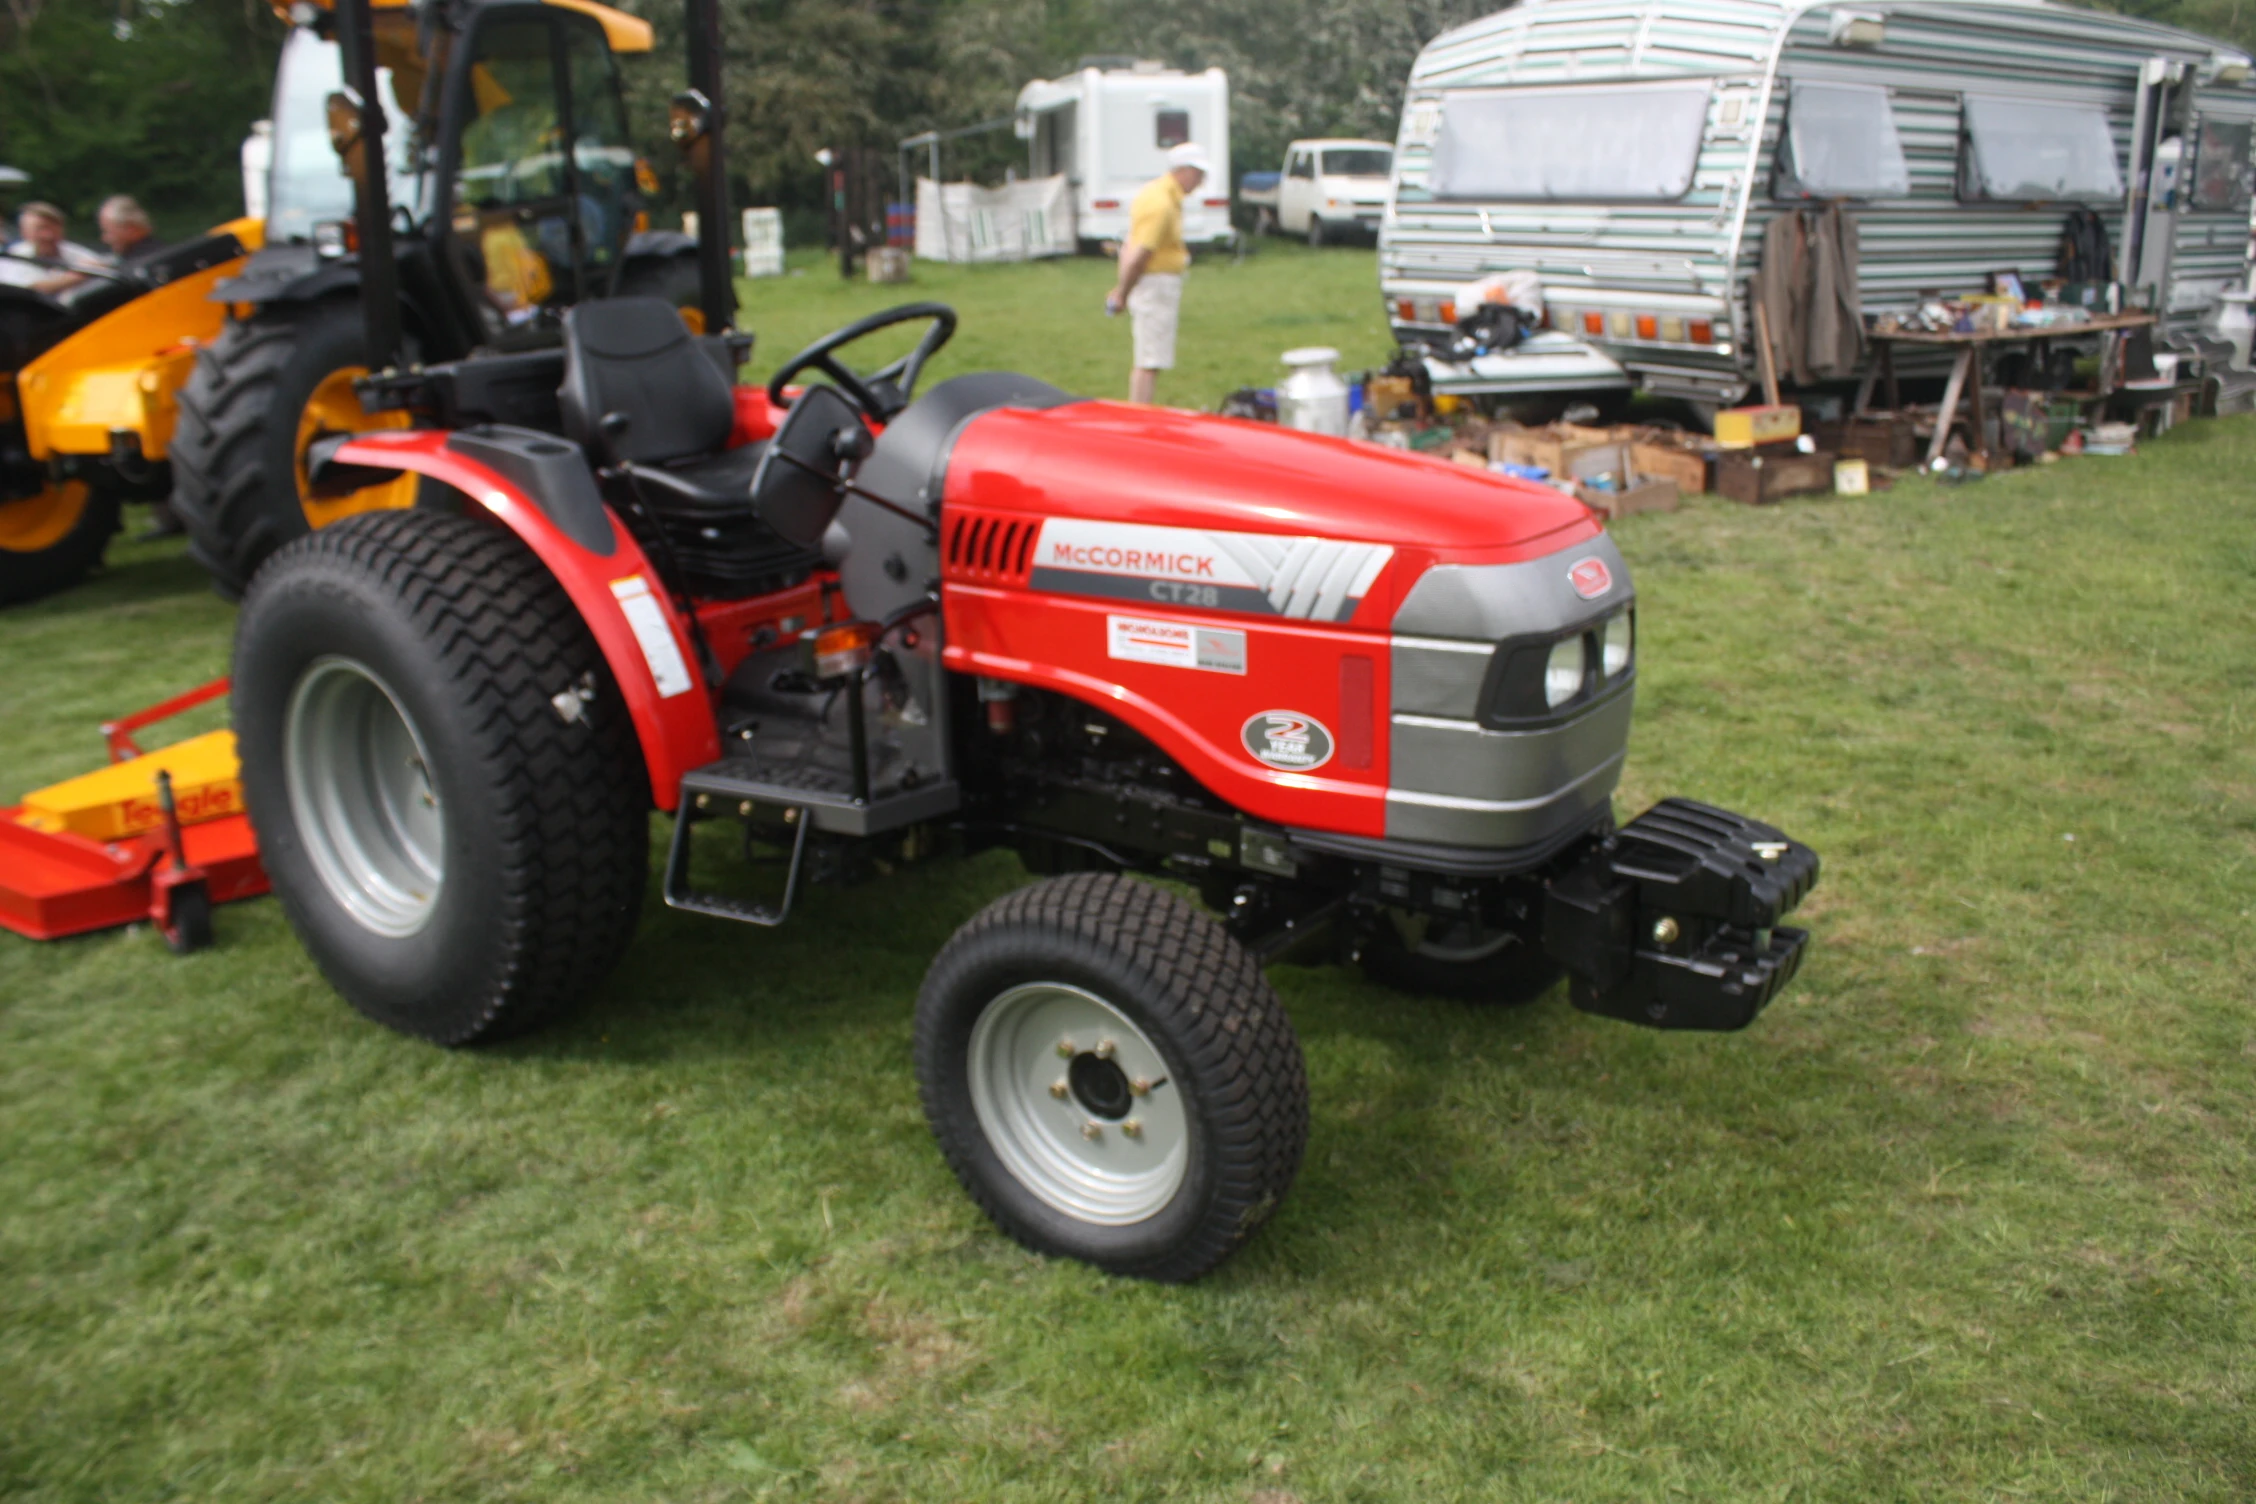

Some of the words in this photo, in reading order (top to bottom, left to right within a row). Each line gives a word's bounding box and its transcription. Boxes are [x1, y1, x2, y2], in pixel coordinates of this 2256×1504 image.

[1053, 543, 1214, 577] McCORMICK
[1149, 580, 1218, 608] CT28
[1264, 714, 1310, 744] 2
[1269, 739, 1306, 755] YEAR
[119, 786, 233, 825] Tegle
